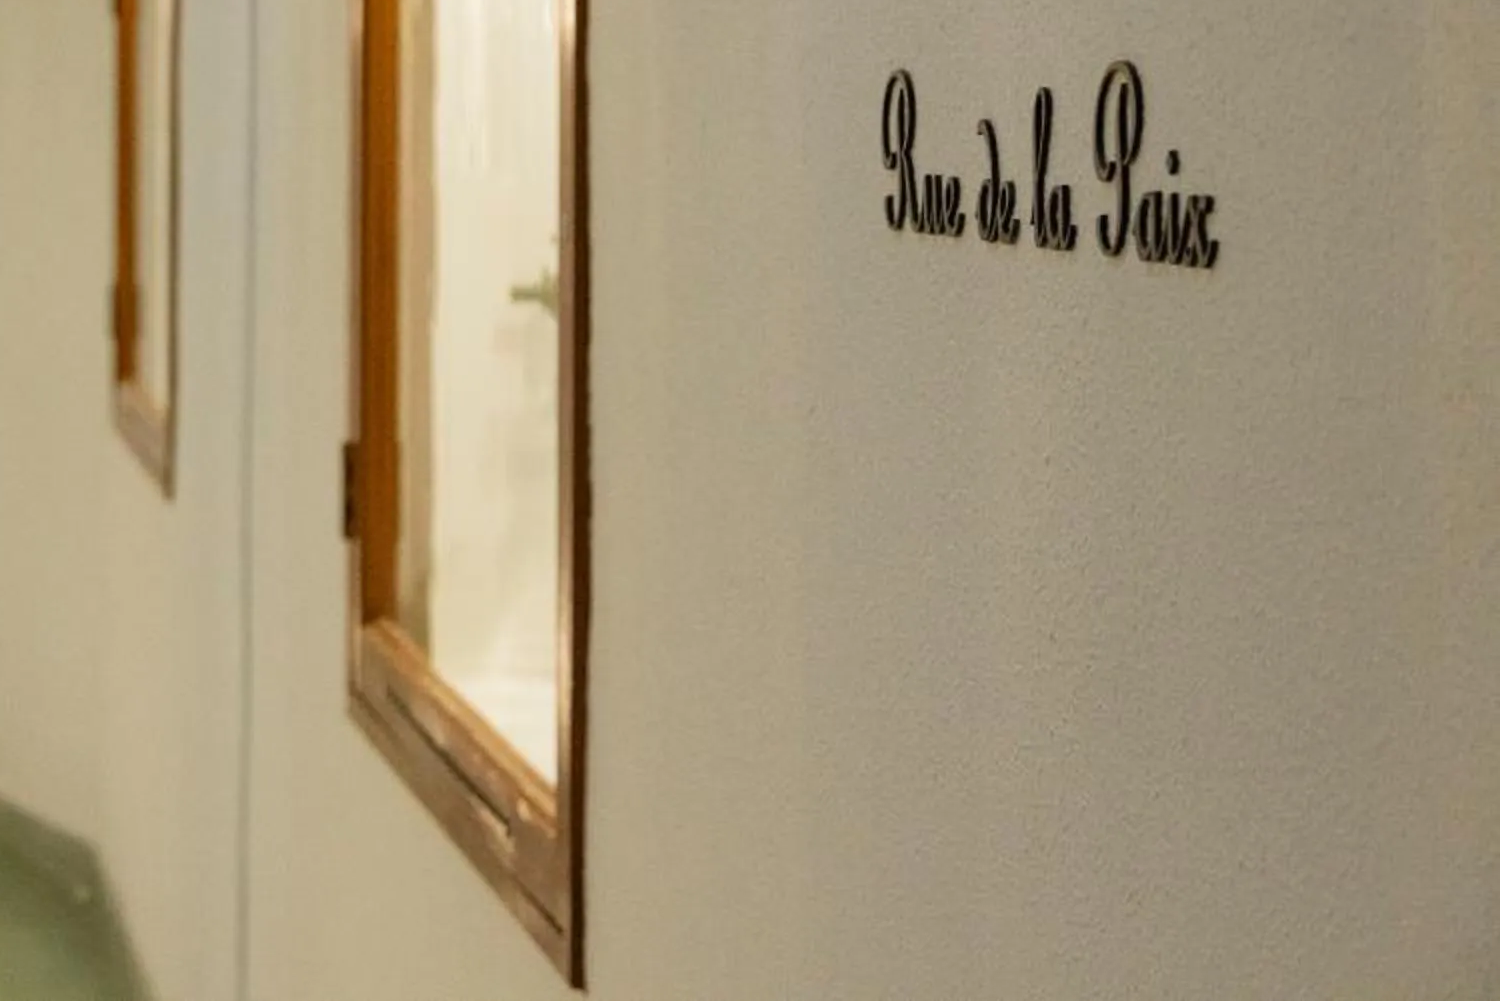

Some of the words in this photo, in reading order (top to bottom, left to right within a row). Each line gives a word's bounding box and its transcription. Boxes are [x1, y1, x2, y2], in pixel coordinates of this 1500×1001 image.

[882, 69, 966, 239] Rue
[975, 118, 1021, 245] de
[1030, 86, 1079, 252] la
[1094, 59, 1220, 269] Paix
